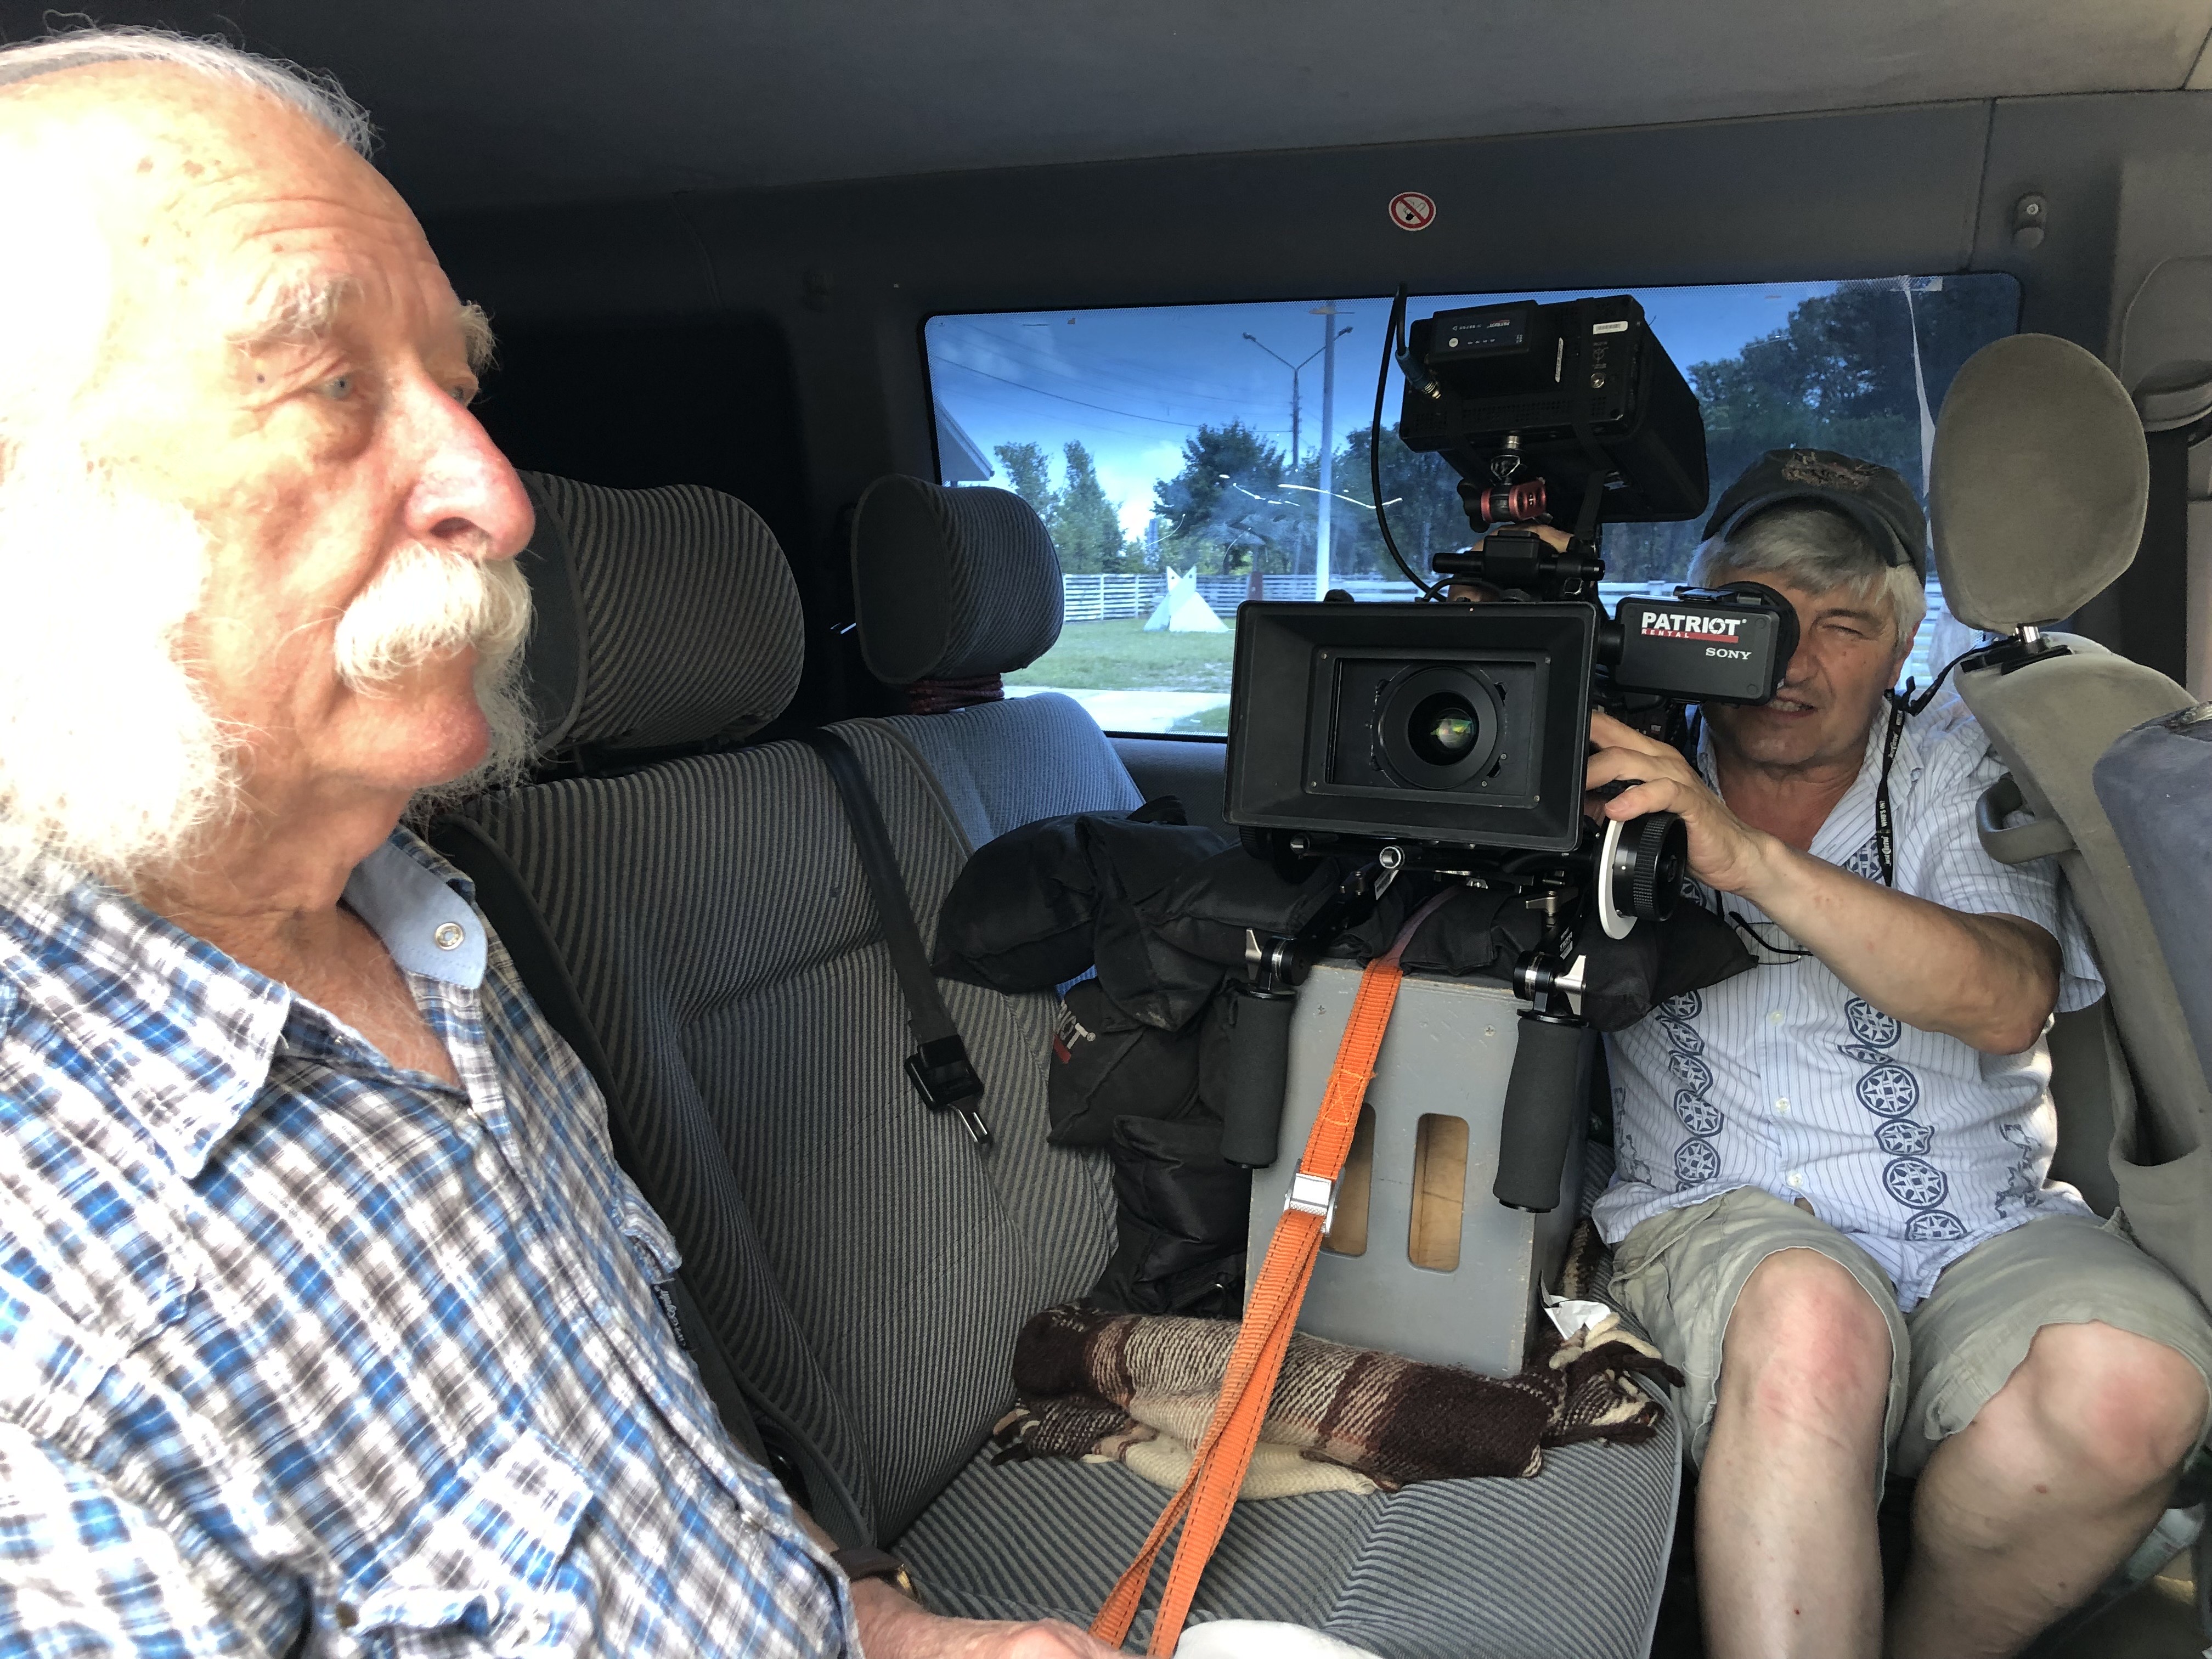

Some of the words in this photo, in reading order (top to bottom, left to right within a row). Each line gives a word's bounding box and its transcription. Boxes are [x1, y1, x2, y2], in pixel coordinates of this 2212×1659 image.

[1641, 612, 1741, 636] PATRIOT
[1641, 629, 1689, 638] RENTAL
[1706, 647, 1752, 660] SONY
